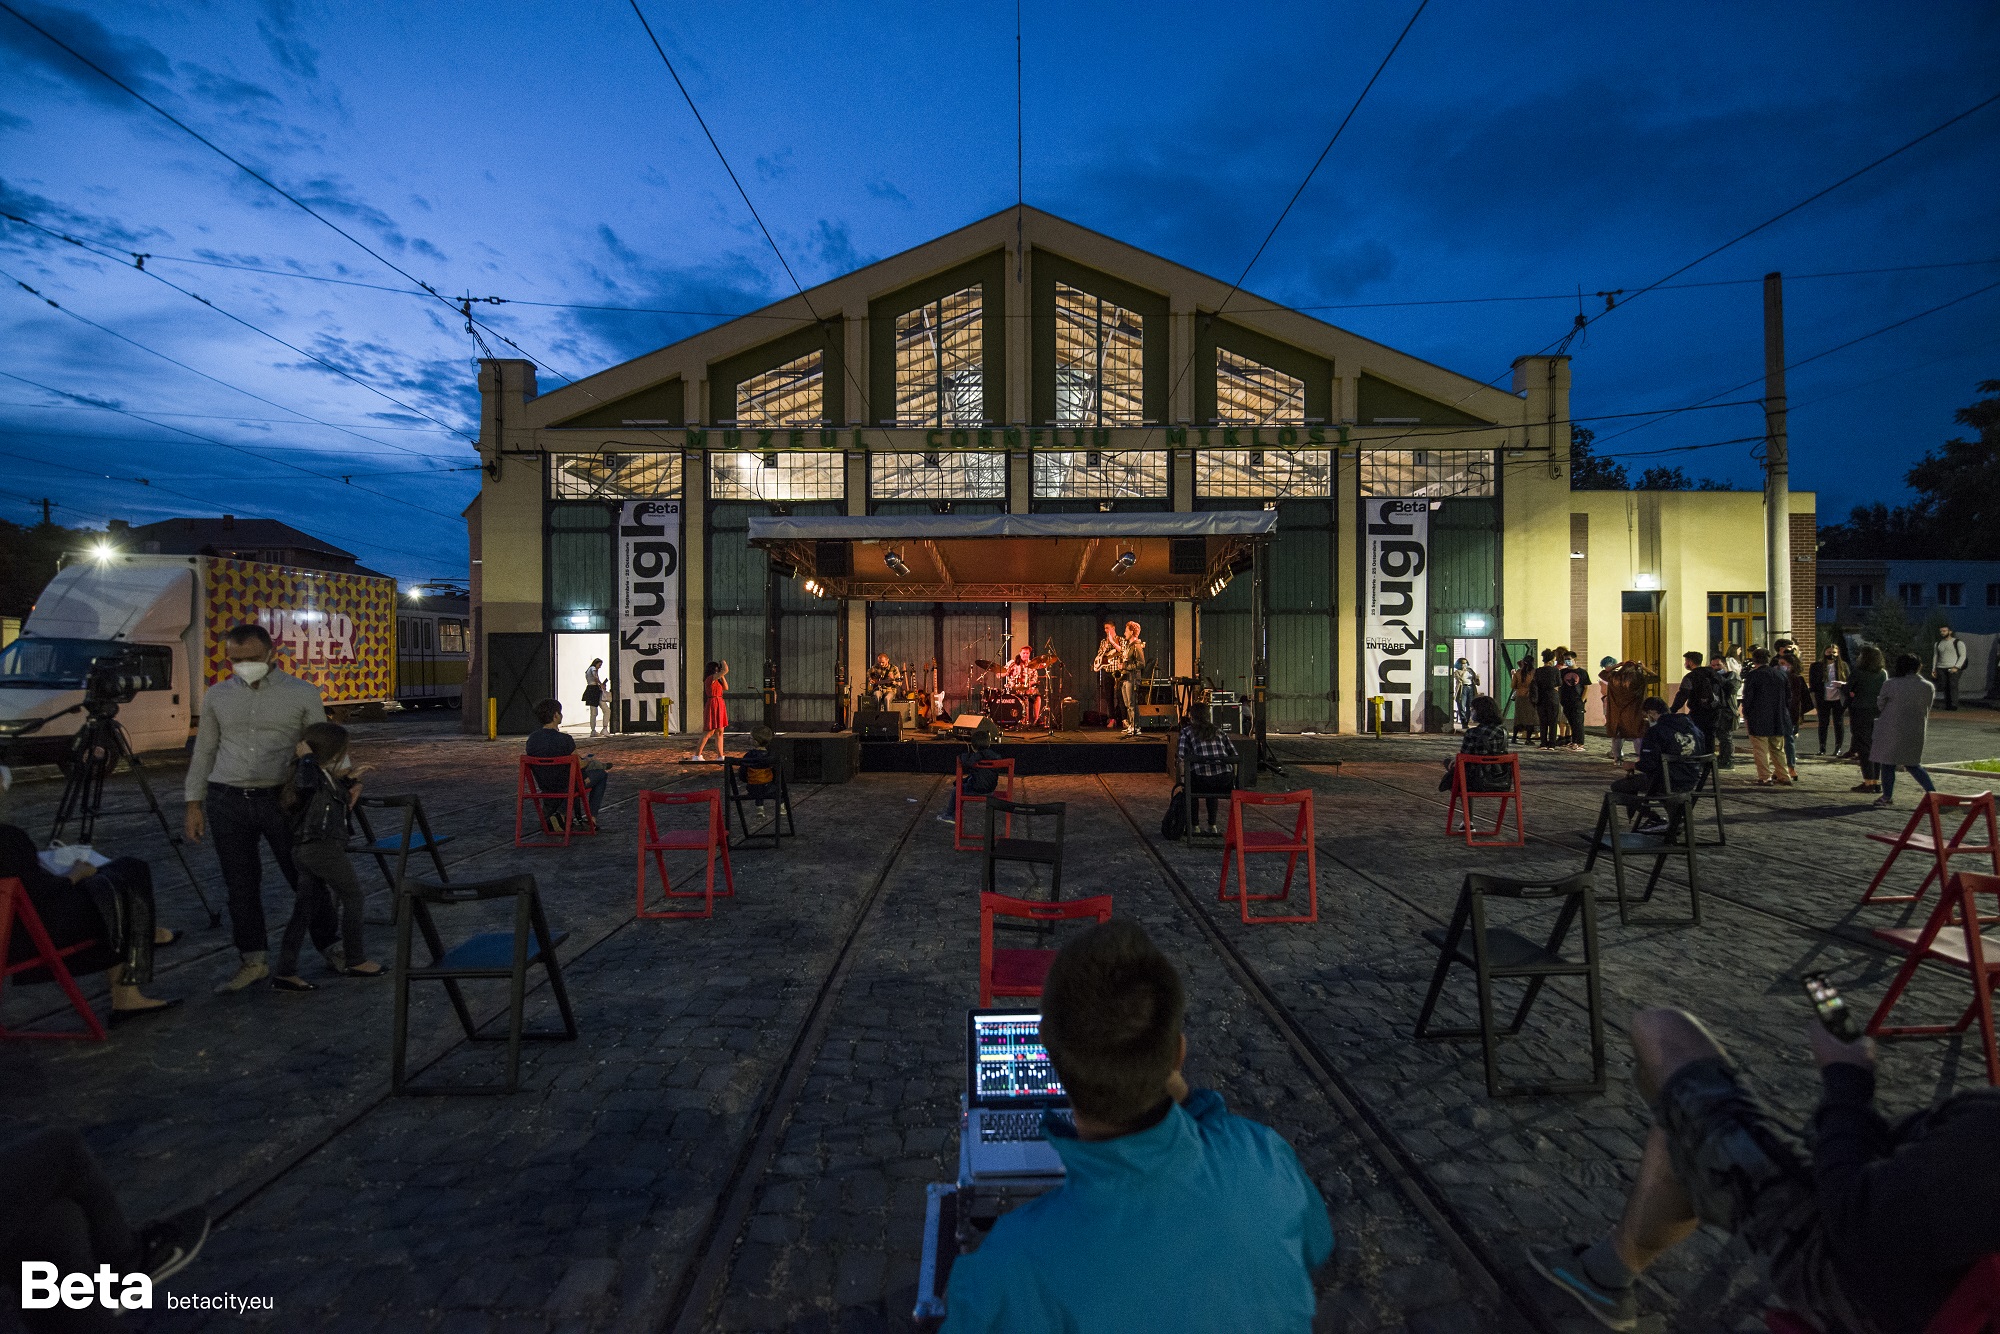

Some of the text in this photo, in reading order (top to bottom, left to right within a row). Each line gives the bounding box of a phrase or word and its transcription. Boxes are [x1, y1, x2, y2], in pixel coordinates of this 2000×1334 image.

[686, 429, 868, 449] MUZEUL
[926, 428, 1110, 448] CORNELIU
[606, 455, 615, 467] 6
[766, 455, 775, 467] 5
[1089, 454, 1098, 466] 3
[1252, 453, 1261, 465] 2
[647, 502, 679, 514] Beta
[1394, 500, 1427, 513] Beta
[288, 637, 355, 660] TECA
